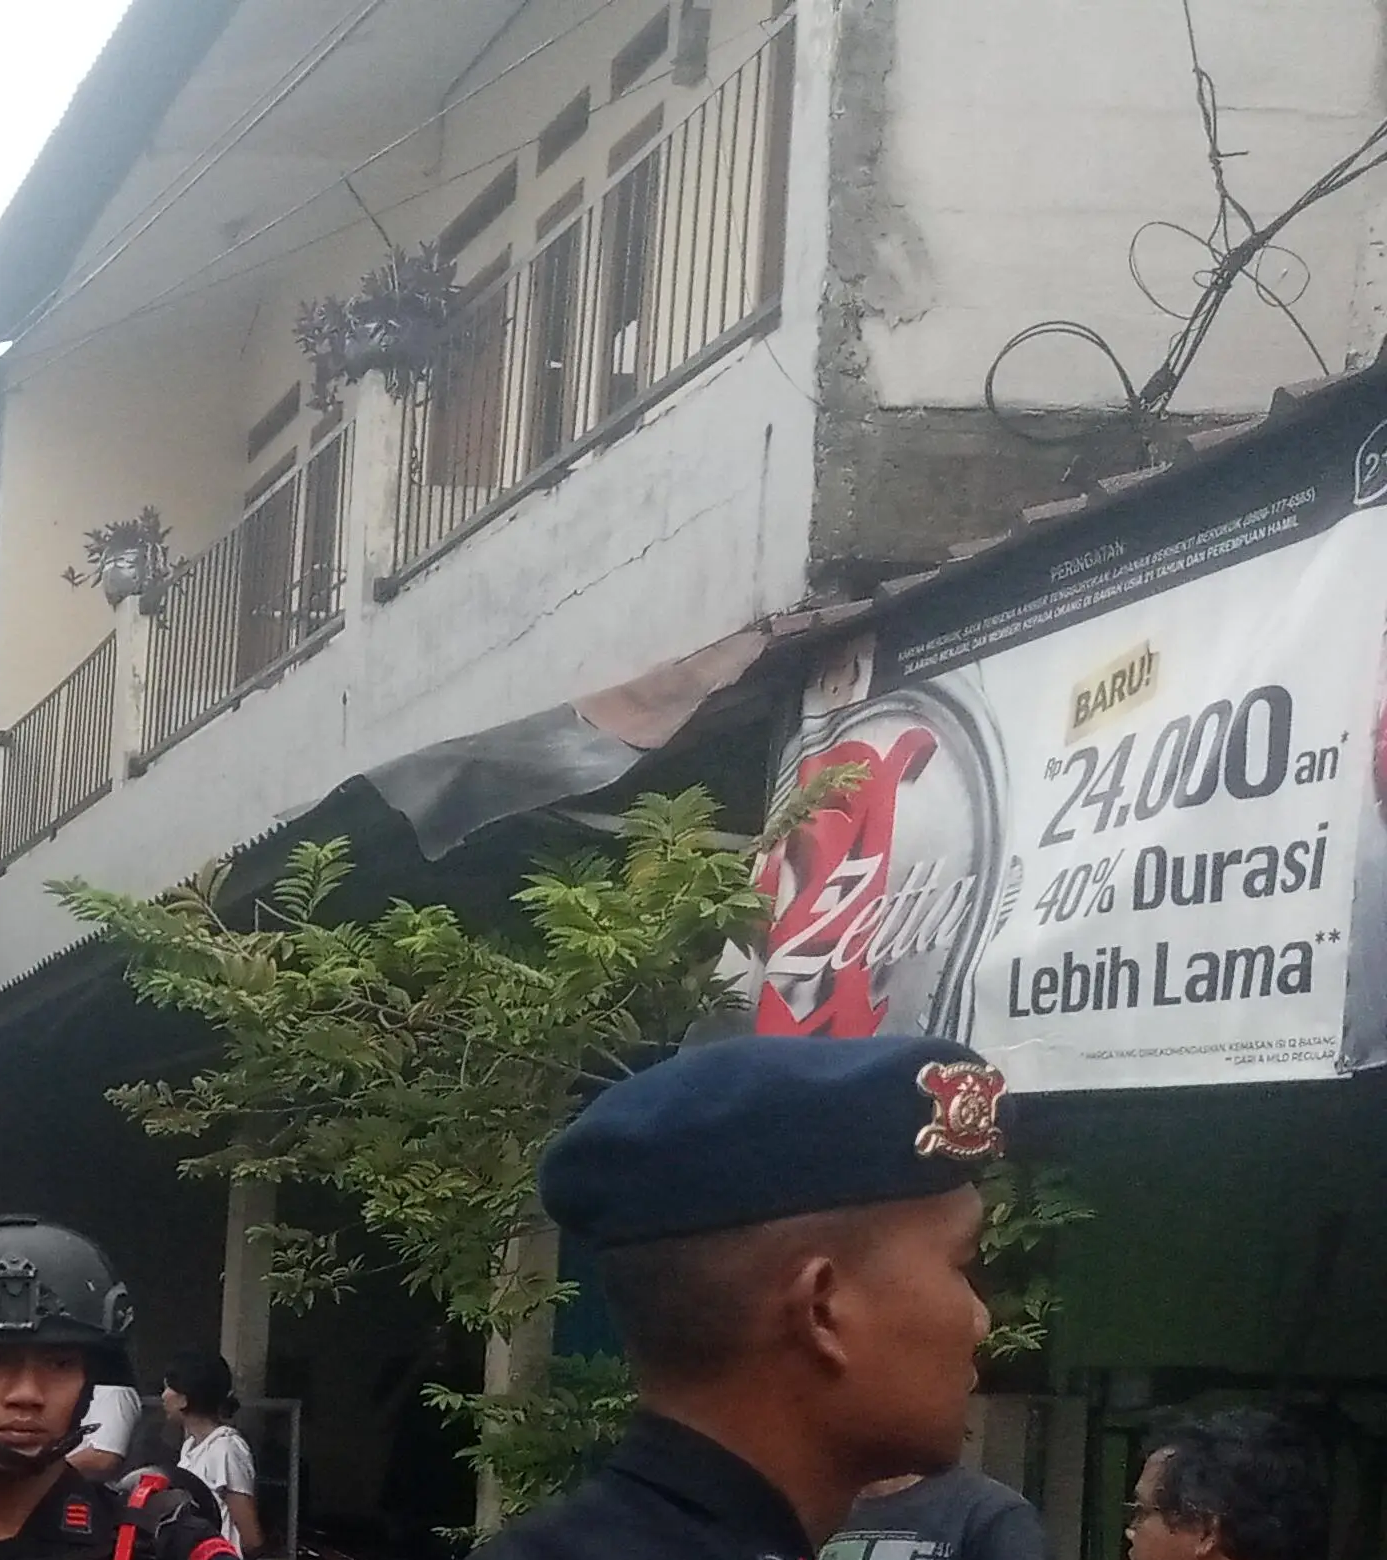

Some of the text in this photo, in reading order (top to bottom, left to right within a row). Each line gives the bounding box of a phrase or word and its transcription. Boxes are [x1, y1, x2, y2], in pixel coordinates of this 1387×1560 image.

[1072, 649, 1155, 728] BARU!
[1044, 757, 1063, 781] Rp
[1034, 849, 1125, 925] 40%
[1133, 821, 1329, 910] Durasi
[1009, 946, 1141, 1017] Lebih
